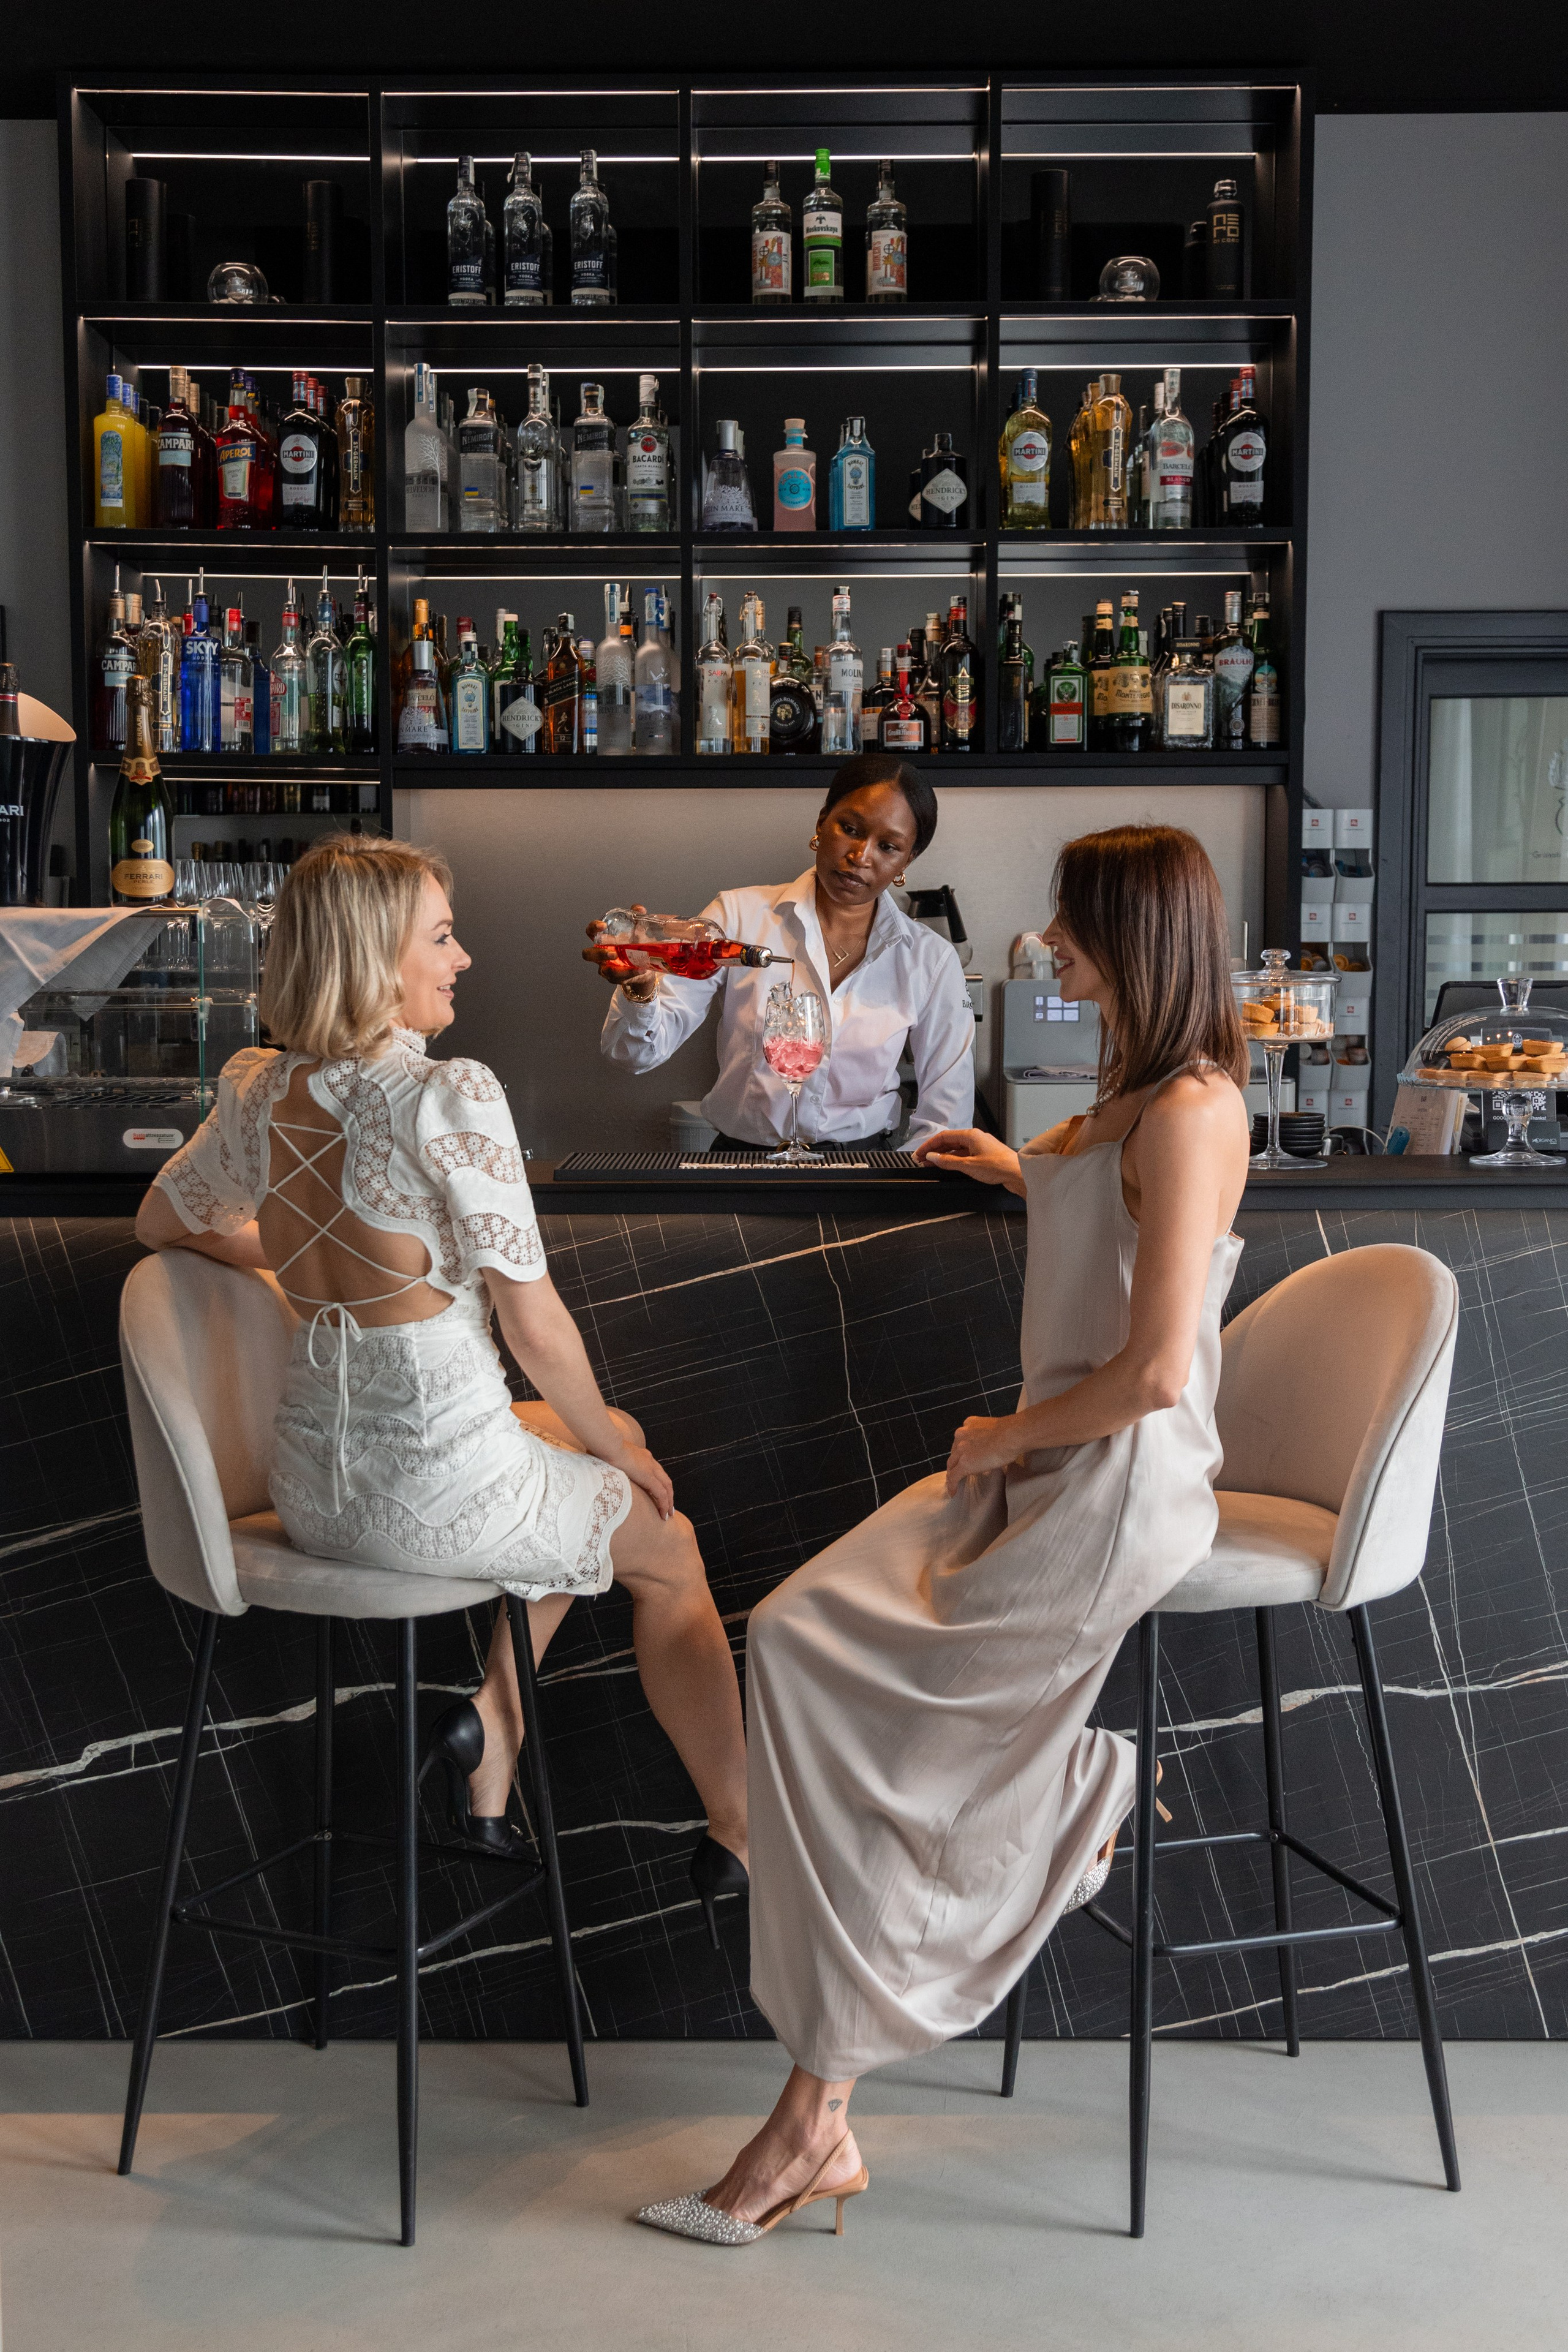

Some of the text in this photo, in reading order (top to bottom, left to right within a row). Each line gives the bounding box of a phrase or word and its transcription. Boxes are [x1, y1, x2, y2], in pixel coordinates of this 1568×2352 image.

[452, 265, 481, 274] ERISTOFF
[511, 262, 540, 271] ERISTOFF
[574, 260, 603, 270] ERISTOFF
[158, 438, 194, 450] CAMPARI
[220, 447, 252, 461] APEROL
[186, 641, 219, 655] SKYY
